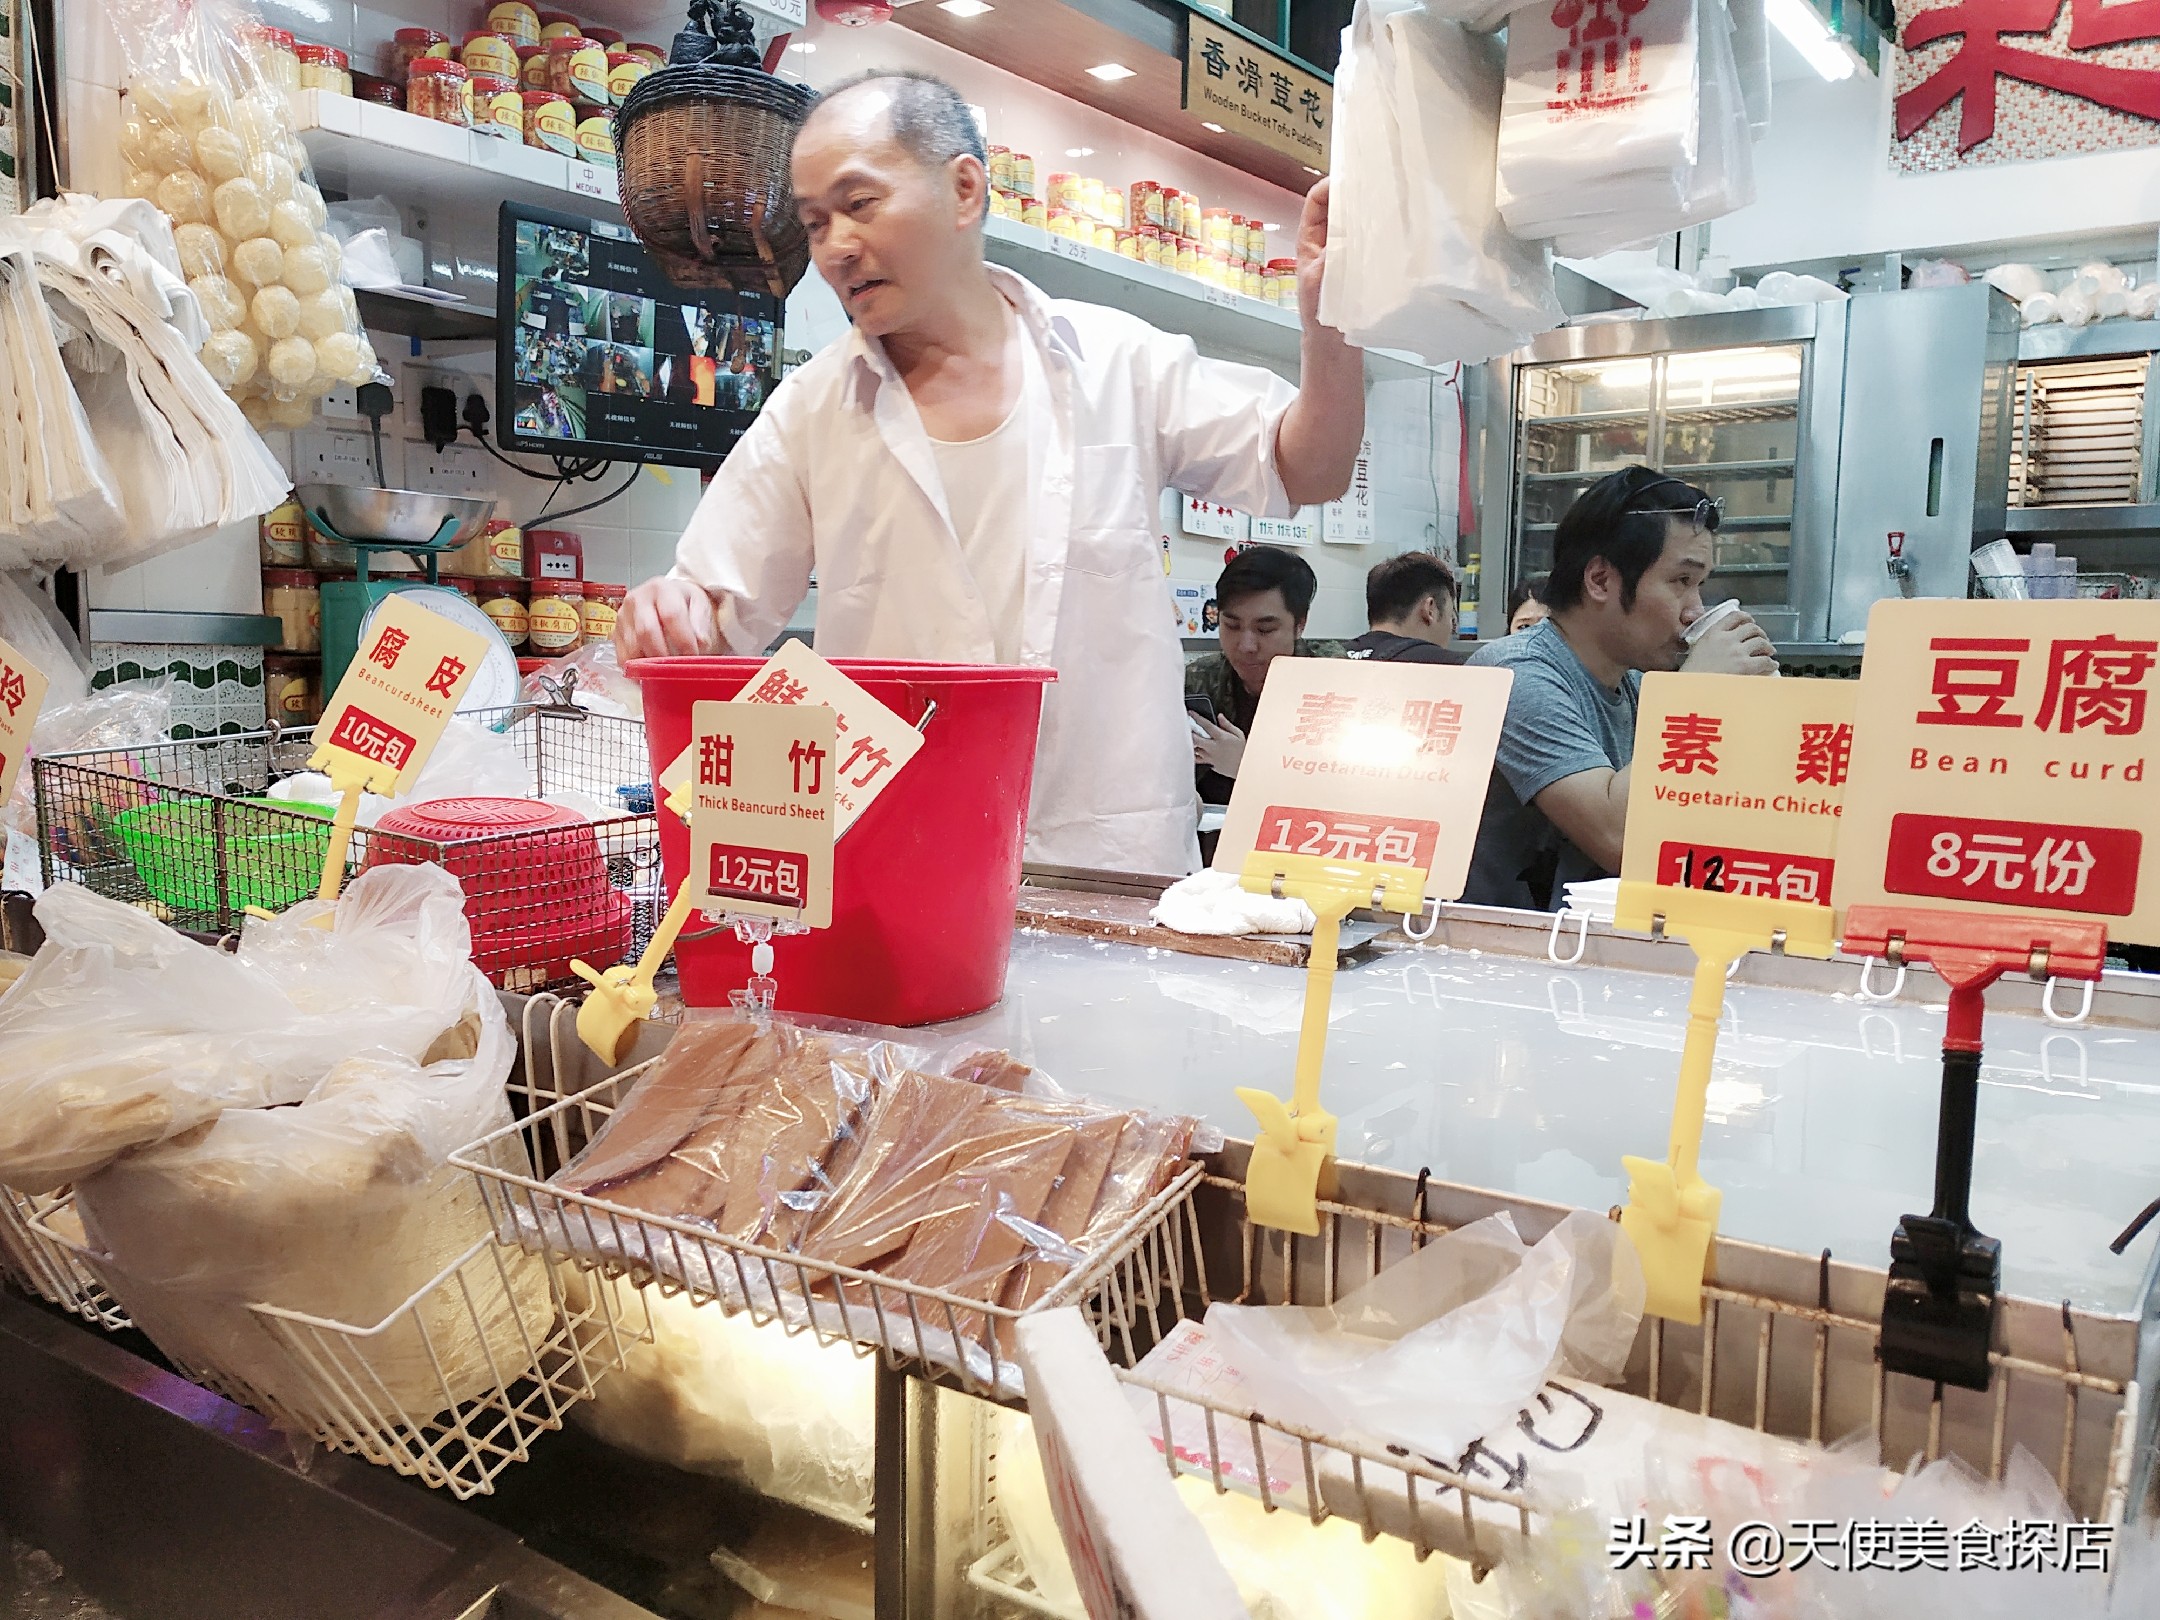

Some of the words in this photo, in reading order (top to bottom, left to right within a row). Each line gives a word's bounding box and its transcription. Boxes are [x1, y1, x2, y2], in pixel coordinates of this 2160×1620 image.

[1200, 37, 1325, 129] 香滑荳花
[1204, 86, 1240, 114] Wooden
[1241, 104, 1271, 129] Bucket
[1271, 118, 1291, 138] Tofu
[1291, 128, 1323, 155] Pudding
[575, 182, 602, 196] MEDIUM
[583, 168, 594, 181] 中
[1259, 521, 1274, 535] 11元
[1276, 523, 1292, 538] 11元
[1292, 525, 1308, 539] 13元
[368, 625, 467, 699] 腐皮
[1915, 633, 2159, 736] 豆腐
[358, 667, 443, 719] Beancurdsheet
[340, 716, 407, 768] 10元包
[747, 668, 893, 788] 鮮竹
[699, 734, 827, 795] 甜竹
[1281, 755, 1392, 780] Vegetarian
[1397, 764, 1450, 784] Duck
[1910, 748, 2009, 775] Bean
[2044, 758, 2145, 783] curd
[699, 794, 728, 811] Thick
[731, 798, 786, 817] Beancurd
[789, 803, 826, 821] Sheet
[1655, 785, 1767, 810] Vegetarian
[1772, 795, 1843, 818] Chicke
[1269, 818, 1420, 868] 12元包
[1926, 832, 2097, 896] 8元份
[718, 855, 801, 897] 12元包
